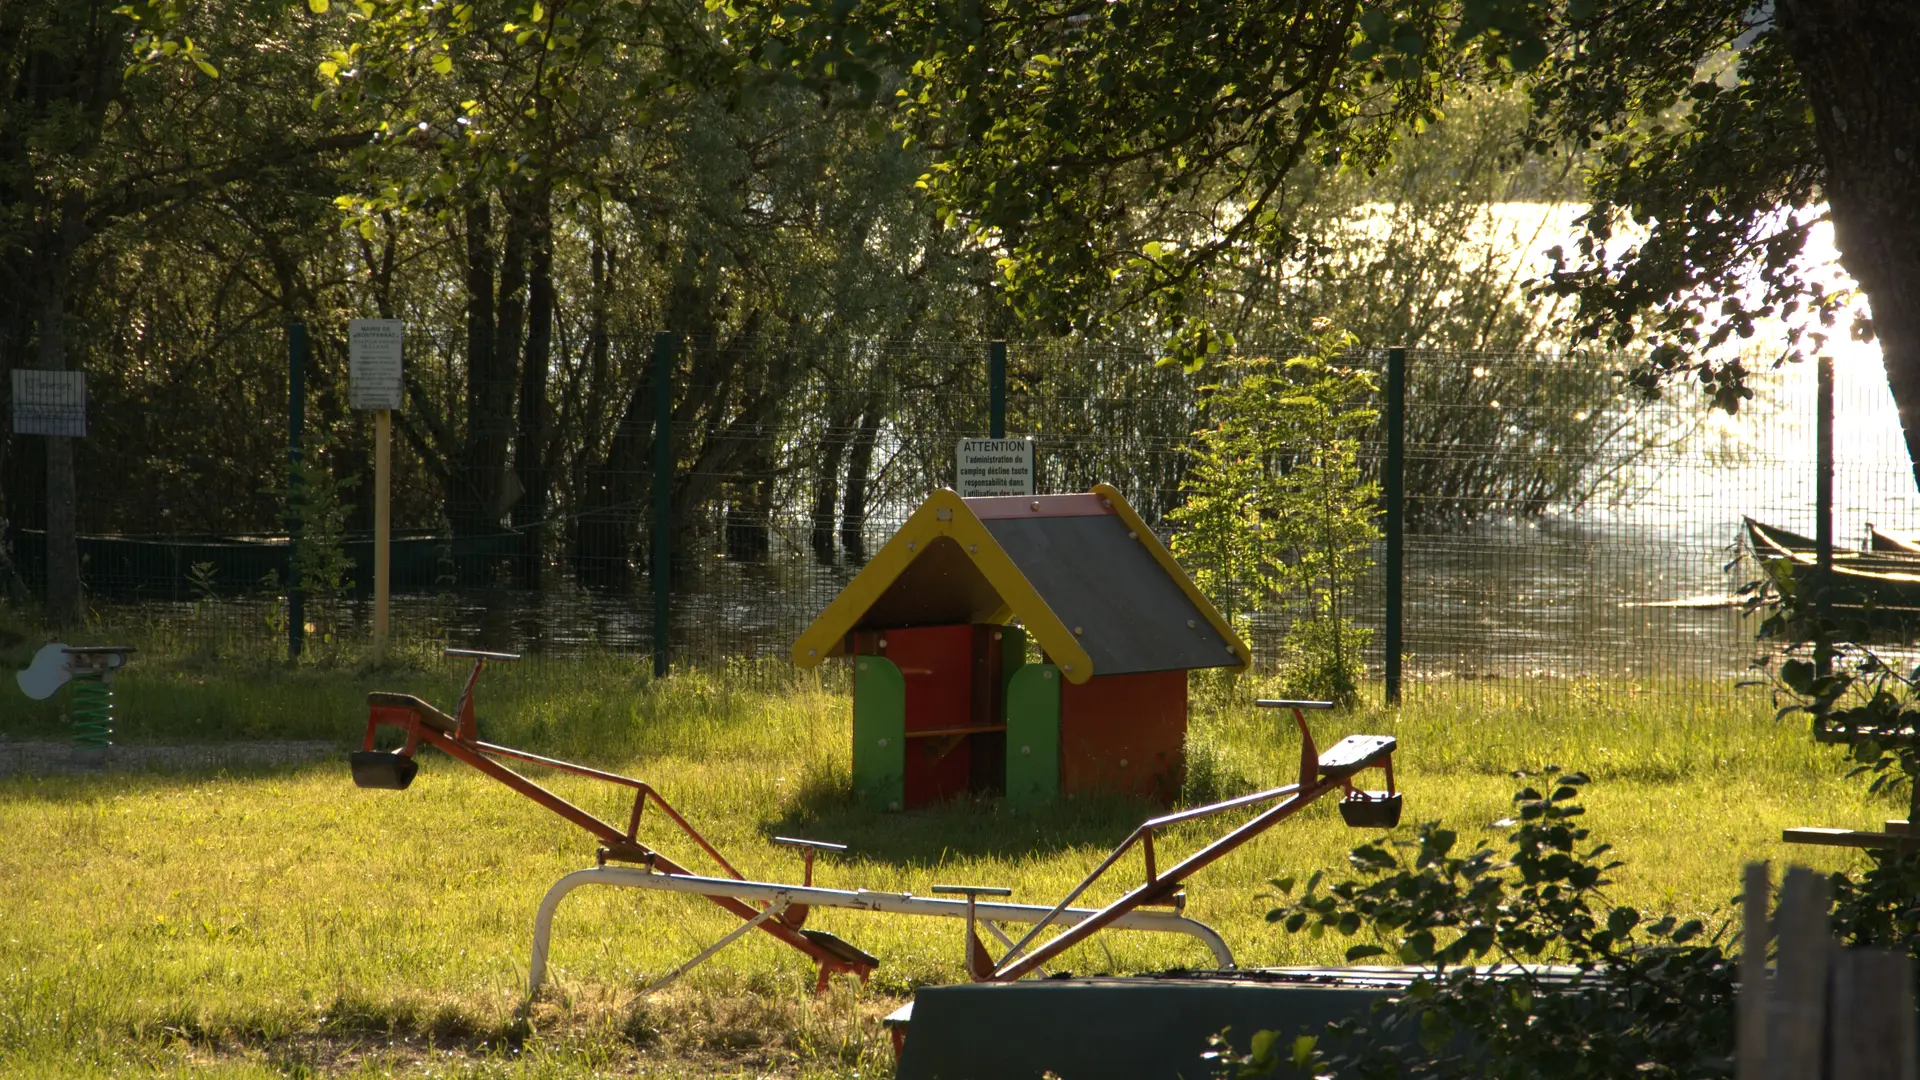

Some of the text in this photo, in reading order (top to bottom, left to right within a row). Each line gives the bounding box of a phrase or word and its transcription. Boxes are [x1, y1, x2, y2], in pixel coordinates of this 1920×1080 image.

[964, 441, 1025, 452] ATTENTION
[965, 455, 1023, 464] l'administration du
[960, 466, 1029, 476] camping décline toute
[964, 477, 1025, 488] responsabilité dans
